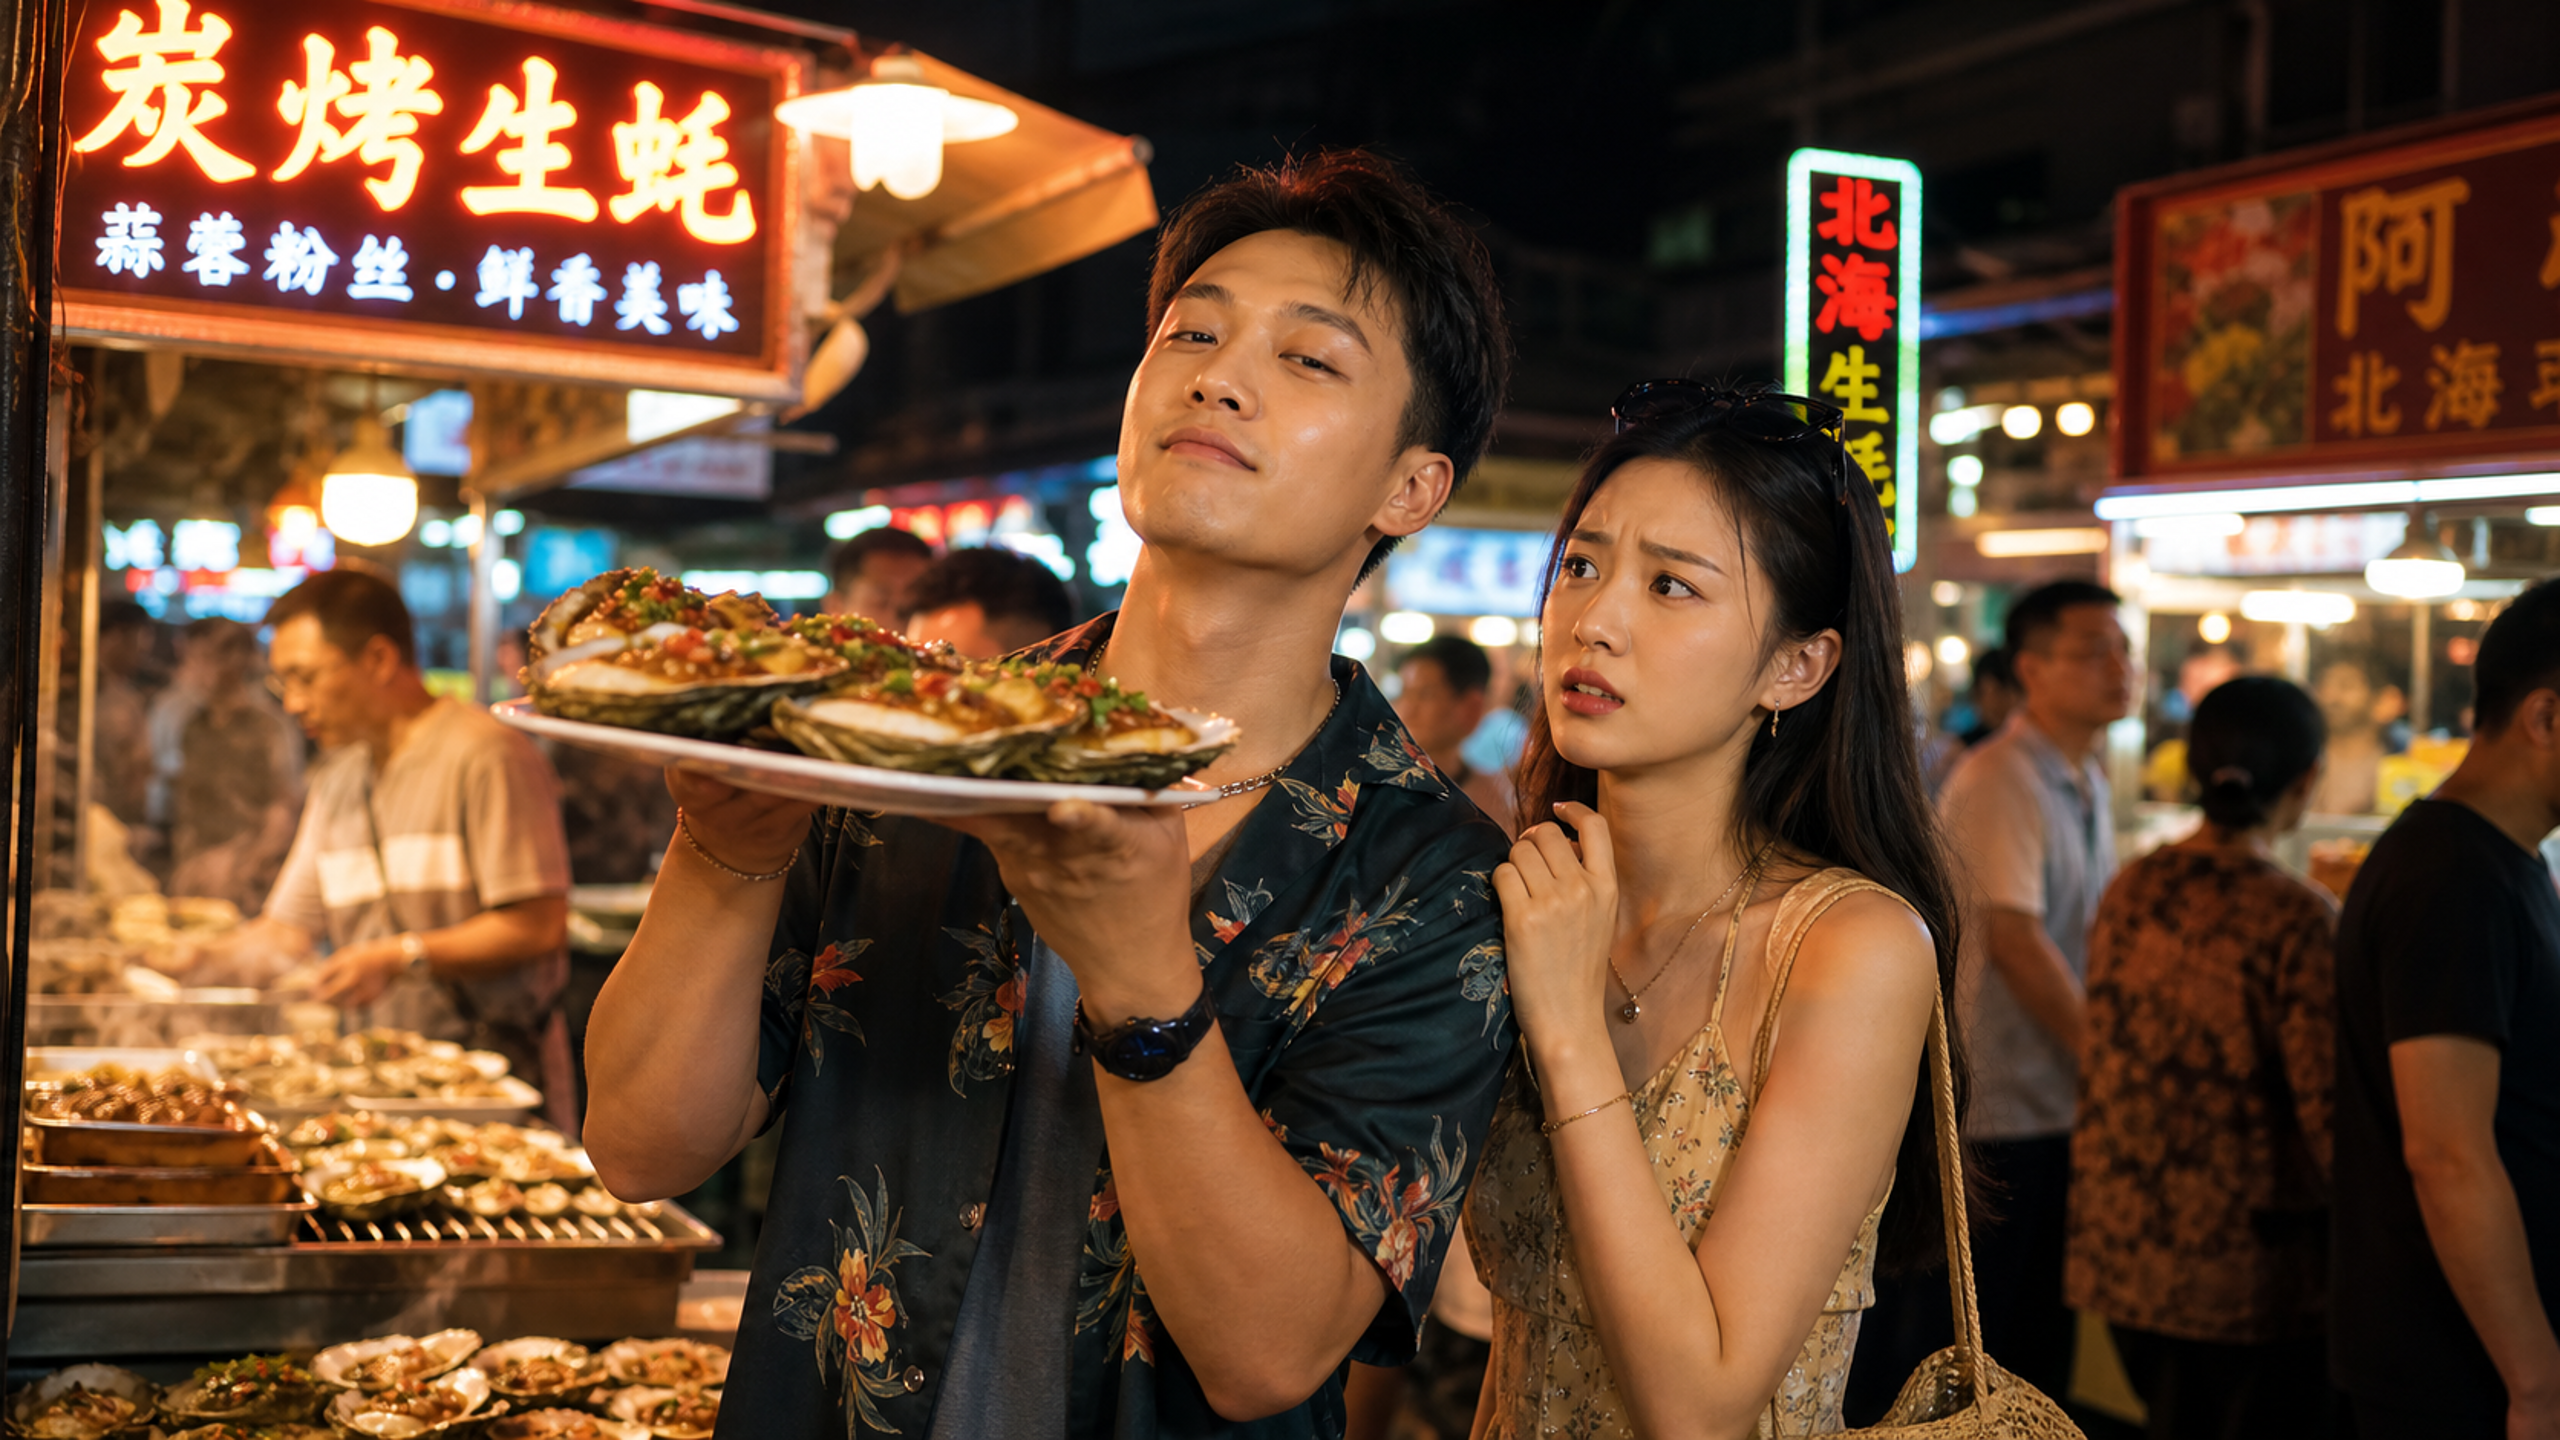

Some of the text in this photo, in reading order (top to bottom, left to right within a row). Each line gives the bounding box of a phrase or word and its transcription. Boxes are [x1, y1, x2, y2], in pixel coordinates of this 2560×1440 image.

[73, 0, 757, 245] 炭烤生蚝
[95, 202, 740, 340] 蒜蓉粉丝·鲜香美味
[2336, 177, 2560, 339] 阿
[2331, 338, 2560, 436] 北海
